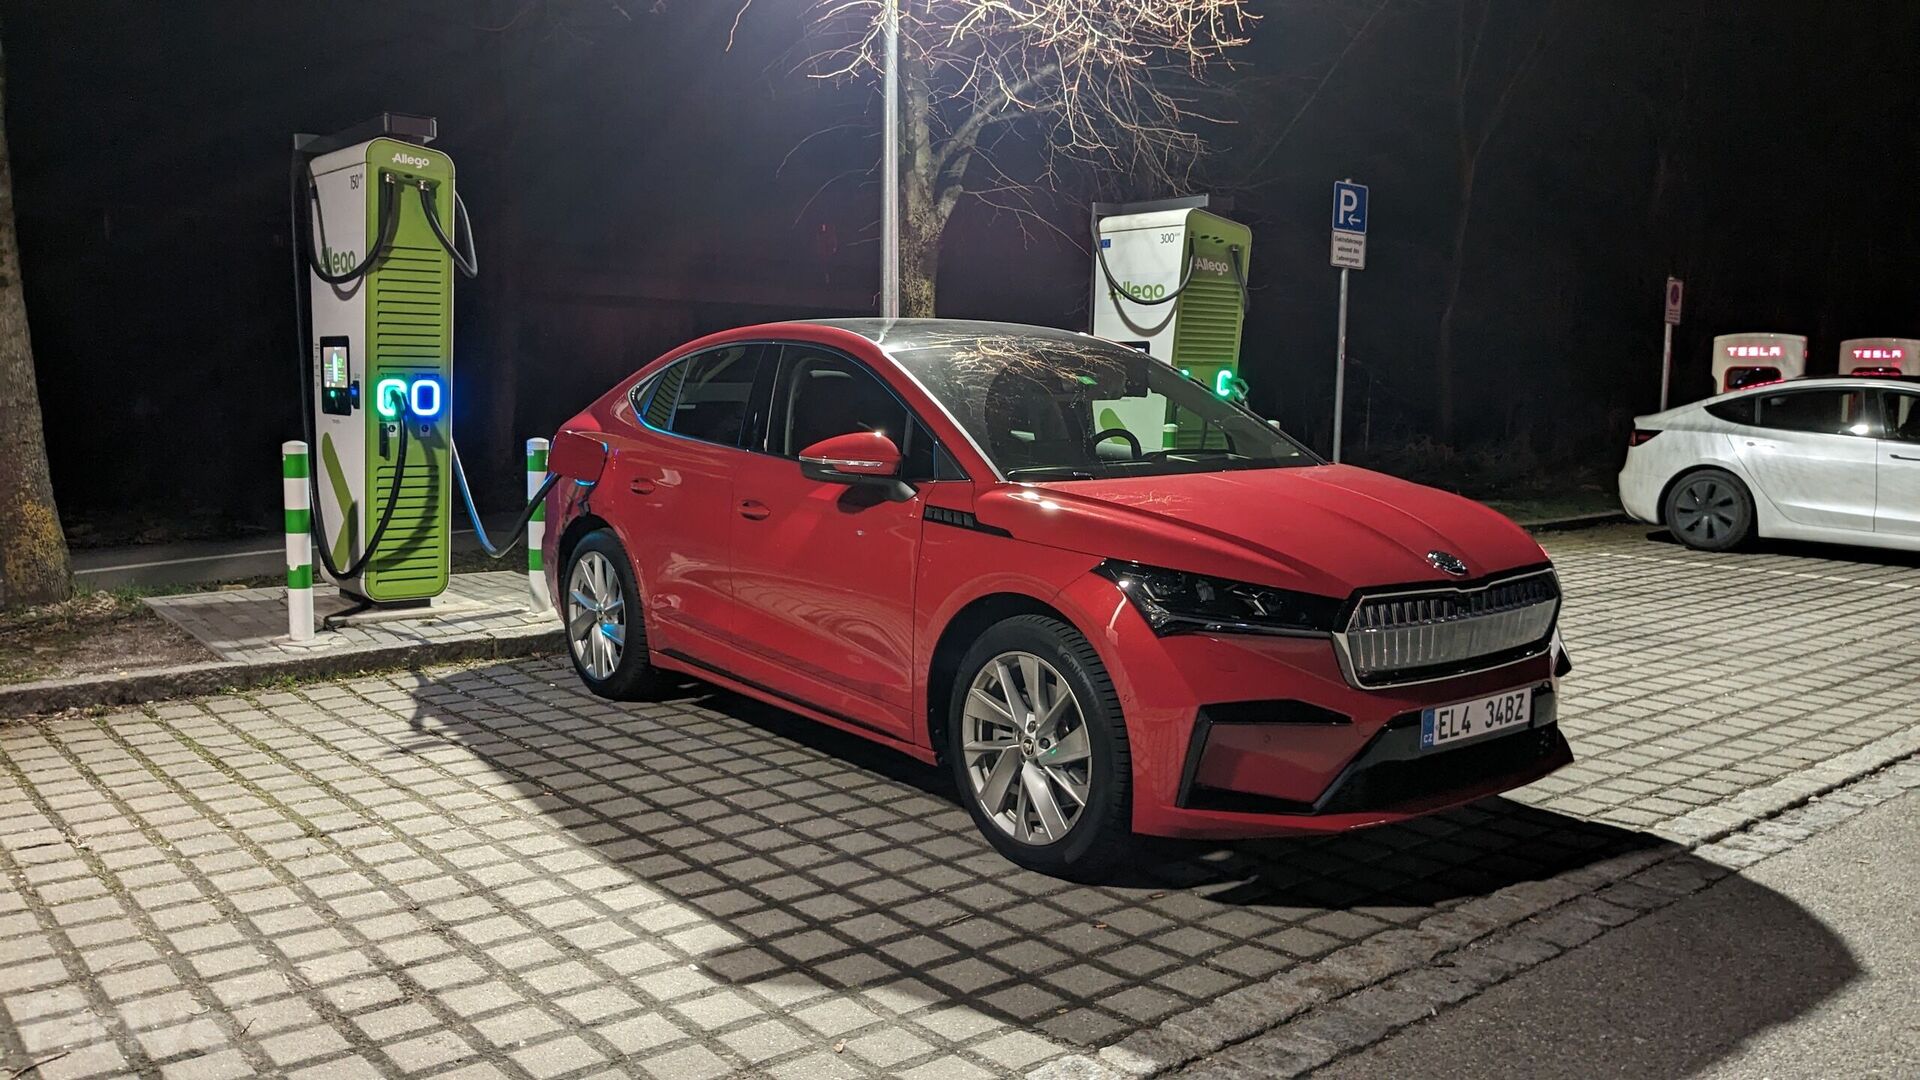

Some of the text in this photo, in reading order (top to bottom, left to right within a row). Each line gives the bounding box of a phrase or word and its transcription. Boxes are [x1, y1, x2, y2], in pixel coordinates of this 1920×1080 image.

[391, 152, 430, 169] Allego
[1338, 189, 1358, 225] P
[1159, 232, 1175, 245] 300
[1194, 256, 1229, 276] Allego
[1727, 346, 1781, 357] TESLA
[1853, 349, 1902, 359] TESLA
[1438, 693, 1524, 740] EL4 34BZ
[1423, 734, 1432, 743] CZ
